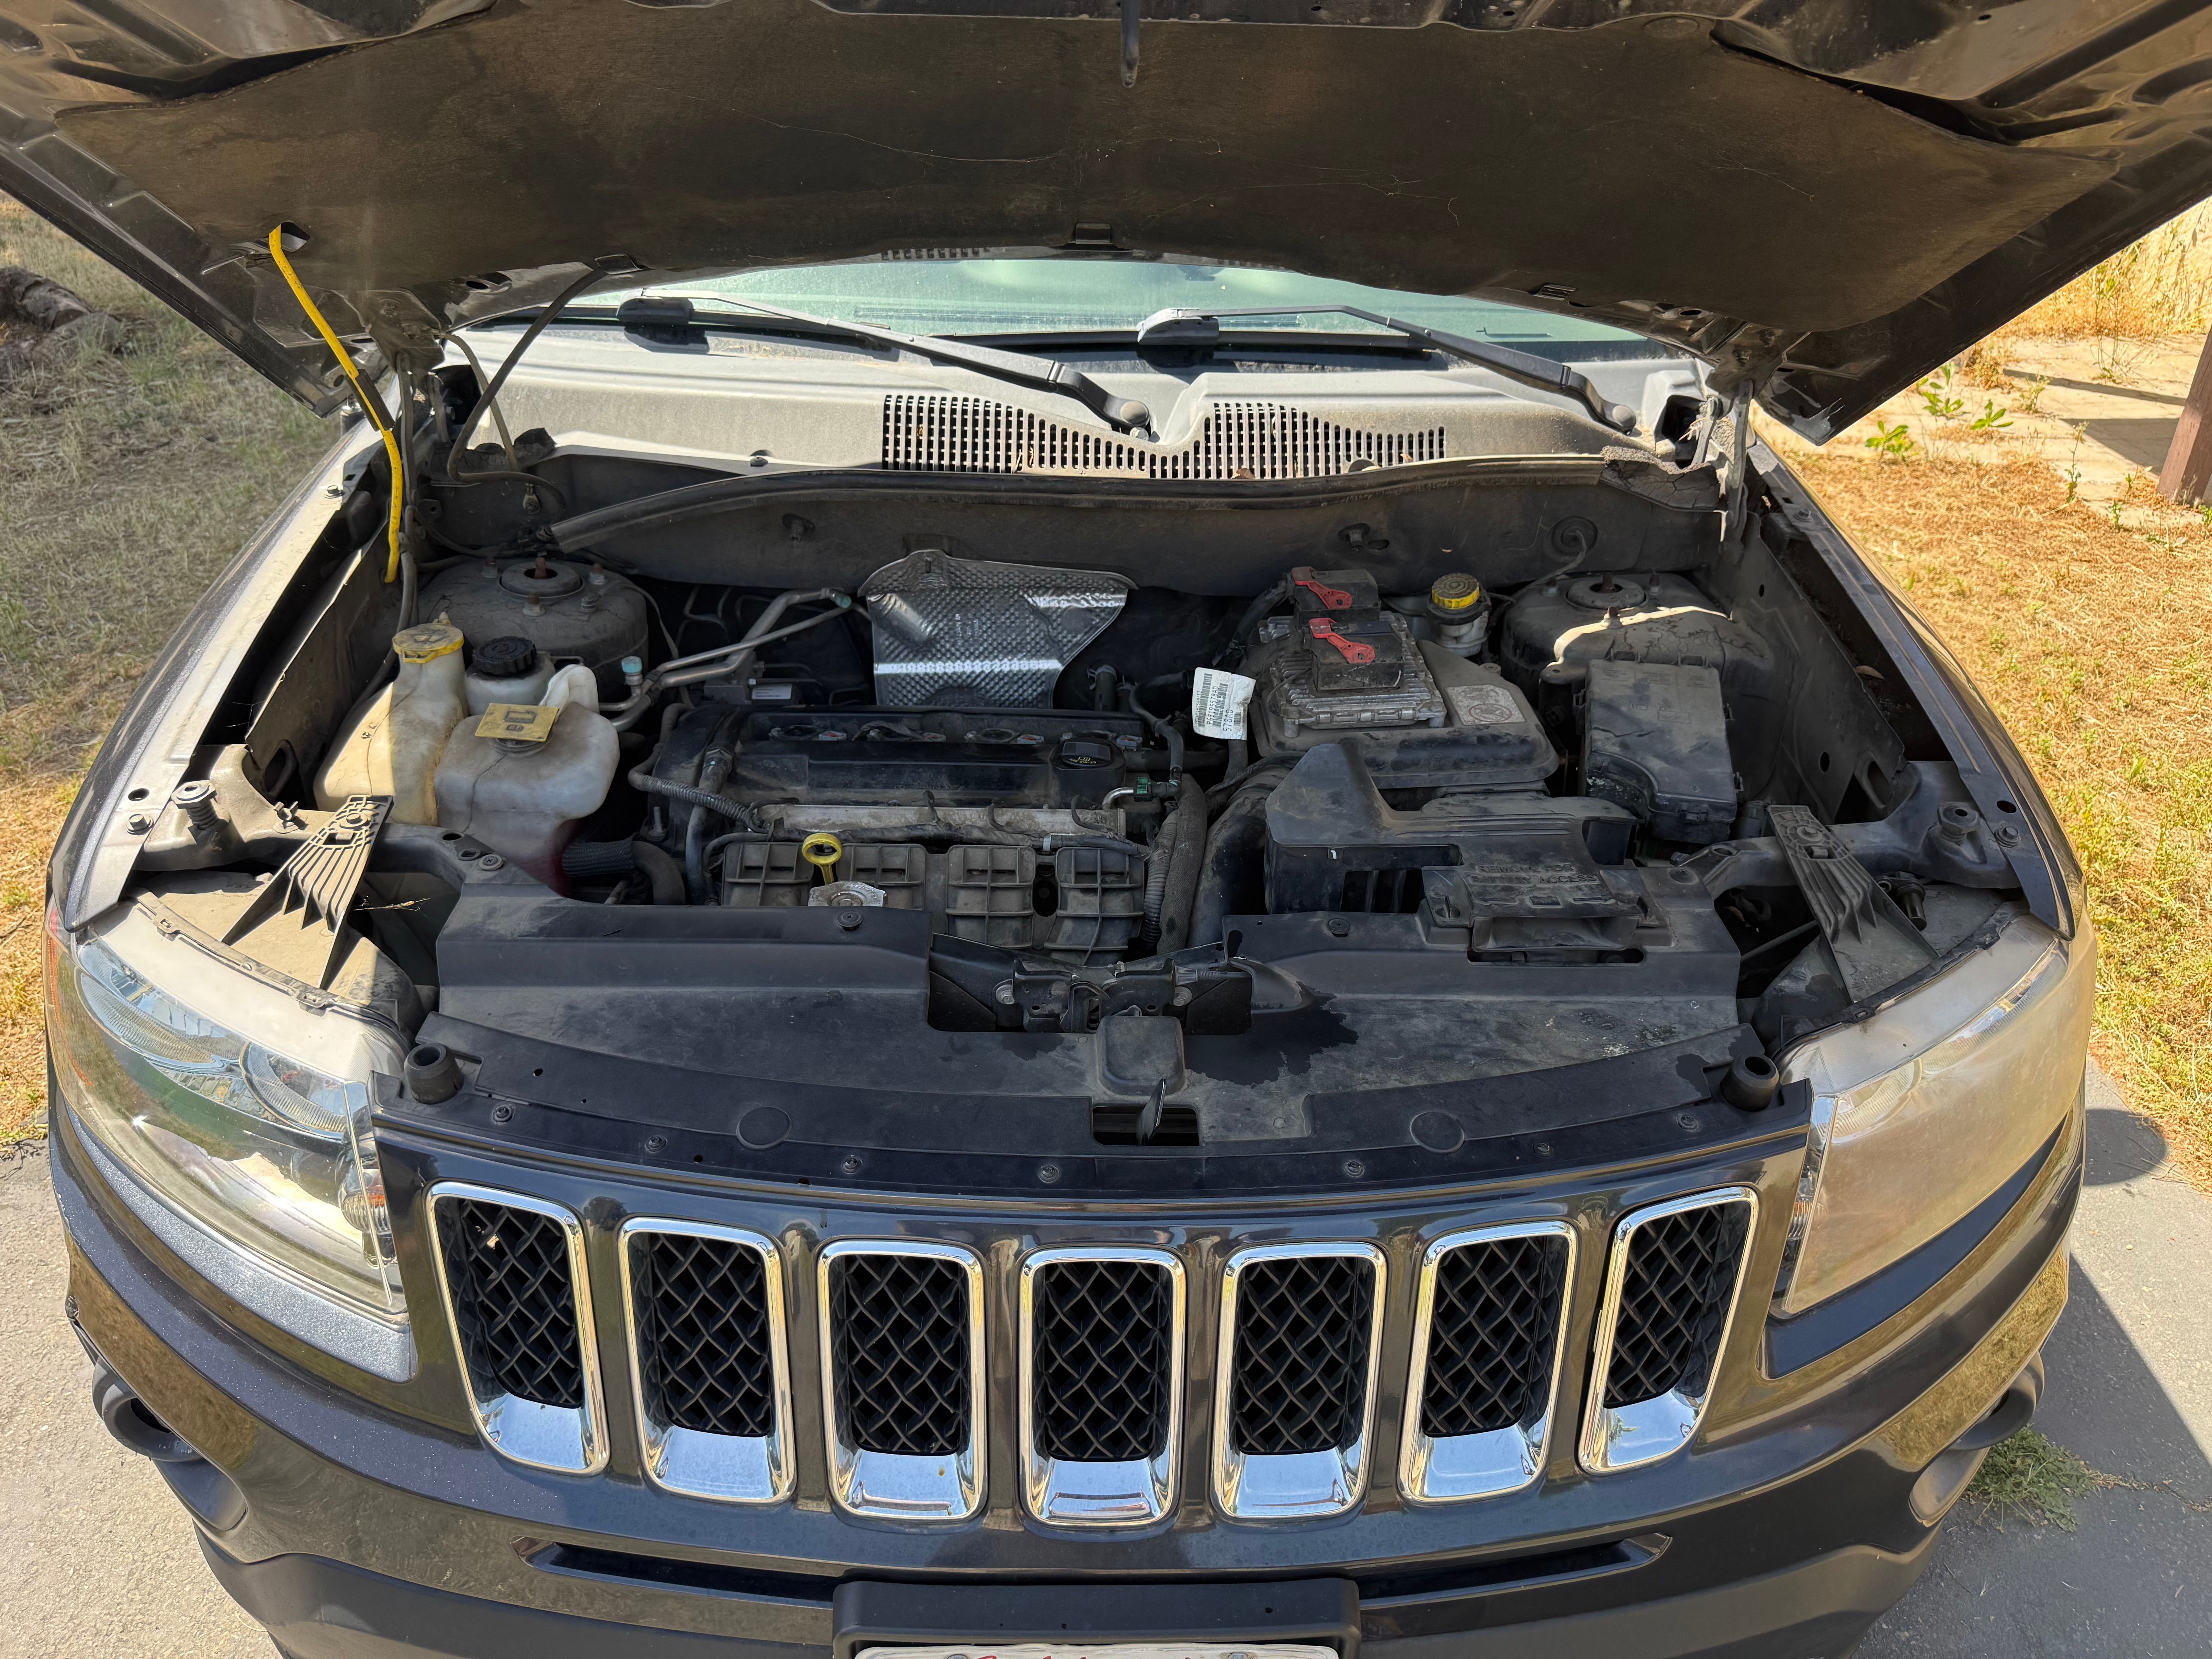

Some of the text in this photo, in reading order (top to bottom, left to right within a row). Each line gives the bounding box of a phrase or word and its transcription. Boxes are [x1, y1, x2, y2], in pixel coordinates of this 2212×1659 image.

[1206, 686, 1219, 725] P68195578AD
[1223, 709, 1233, 732] 578AD
[1479, 865, 1540, 873] REMOVE
[1471, 874, 1597, 884] BATTERY ACCESS
